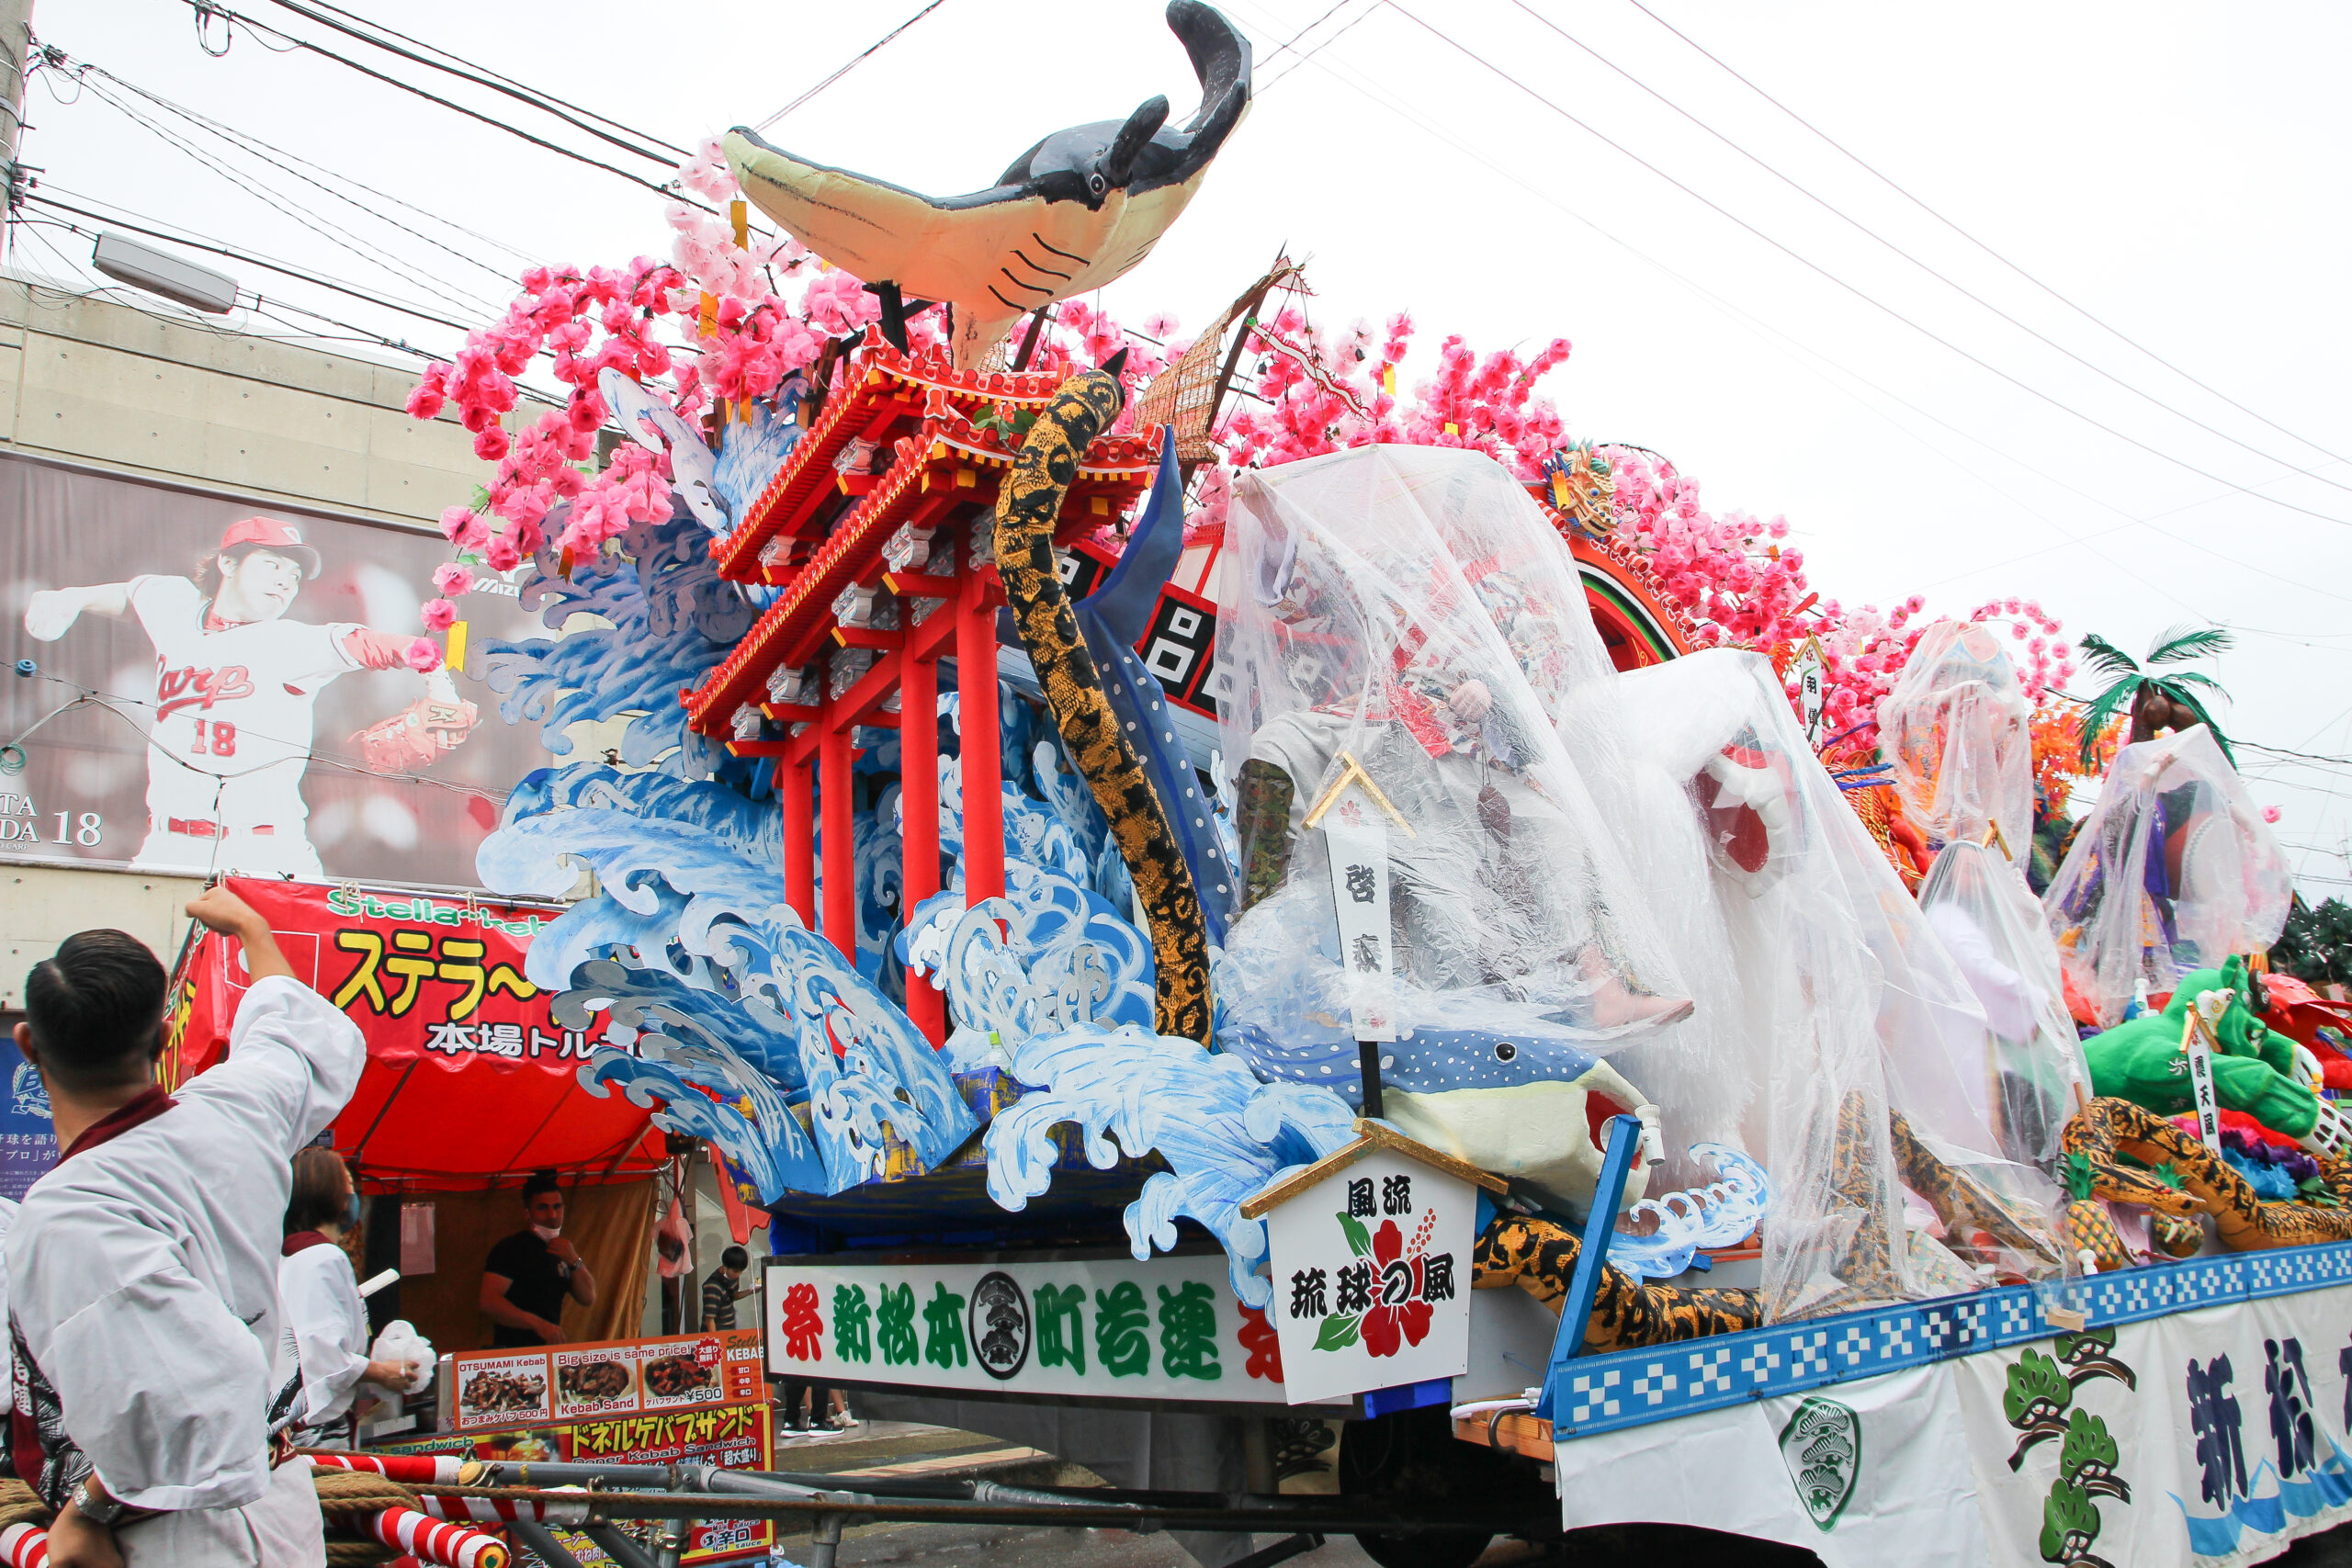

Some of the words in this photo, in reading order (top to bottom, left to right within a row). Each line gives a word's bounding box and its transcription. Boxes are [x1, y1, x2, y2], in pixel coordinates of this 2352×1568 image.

[190, 718, 236, 757] 18
[0, 793, 38, 817] TA
[0, 818, 40, 842] DA
[51, 810, 102, 847] 18
[1347, 1174, 1411, 1218] 風流
[1290, 1252, 1455, 1319] 琉球の風
[781, 1280, 825, 1362] 祭
[558, 1354, 578, 1366] Big
[581, 1352, 606, 1363] size
[610, 1350, 621, 1360] is
[624, 1348, 655, 1359] same
[658, 1344, 691, 1357] price!
[698, 1345, 718, 1354] 大盛り
[726, 1346, 764, 1362] KEBAB
[459, 1360, 514, 1372] OTSUMAMI
[516, 1358, 546, 1367] Kebab
[685, 1388, 722, 1401] ¥500
[560, 1400, 600, 1415] Kebab
[602, 1398, 635, 1411] Sand
[571, 1404, 754, 1458] ドネルケバブサンド
[2187, 1327, 2352, 1512] 新松
[389, 1436, 474, 1454] sandwich
[628, 1448, 680, 1462] Kebab
[684, 1436, 756, 1454] Sandwich
[733, 1518, 761, 1529] sauce
[712, 1544, 729, 1553] Hot
[735, 1540, 762, 1549] sauce
